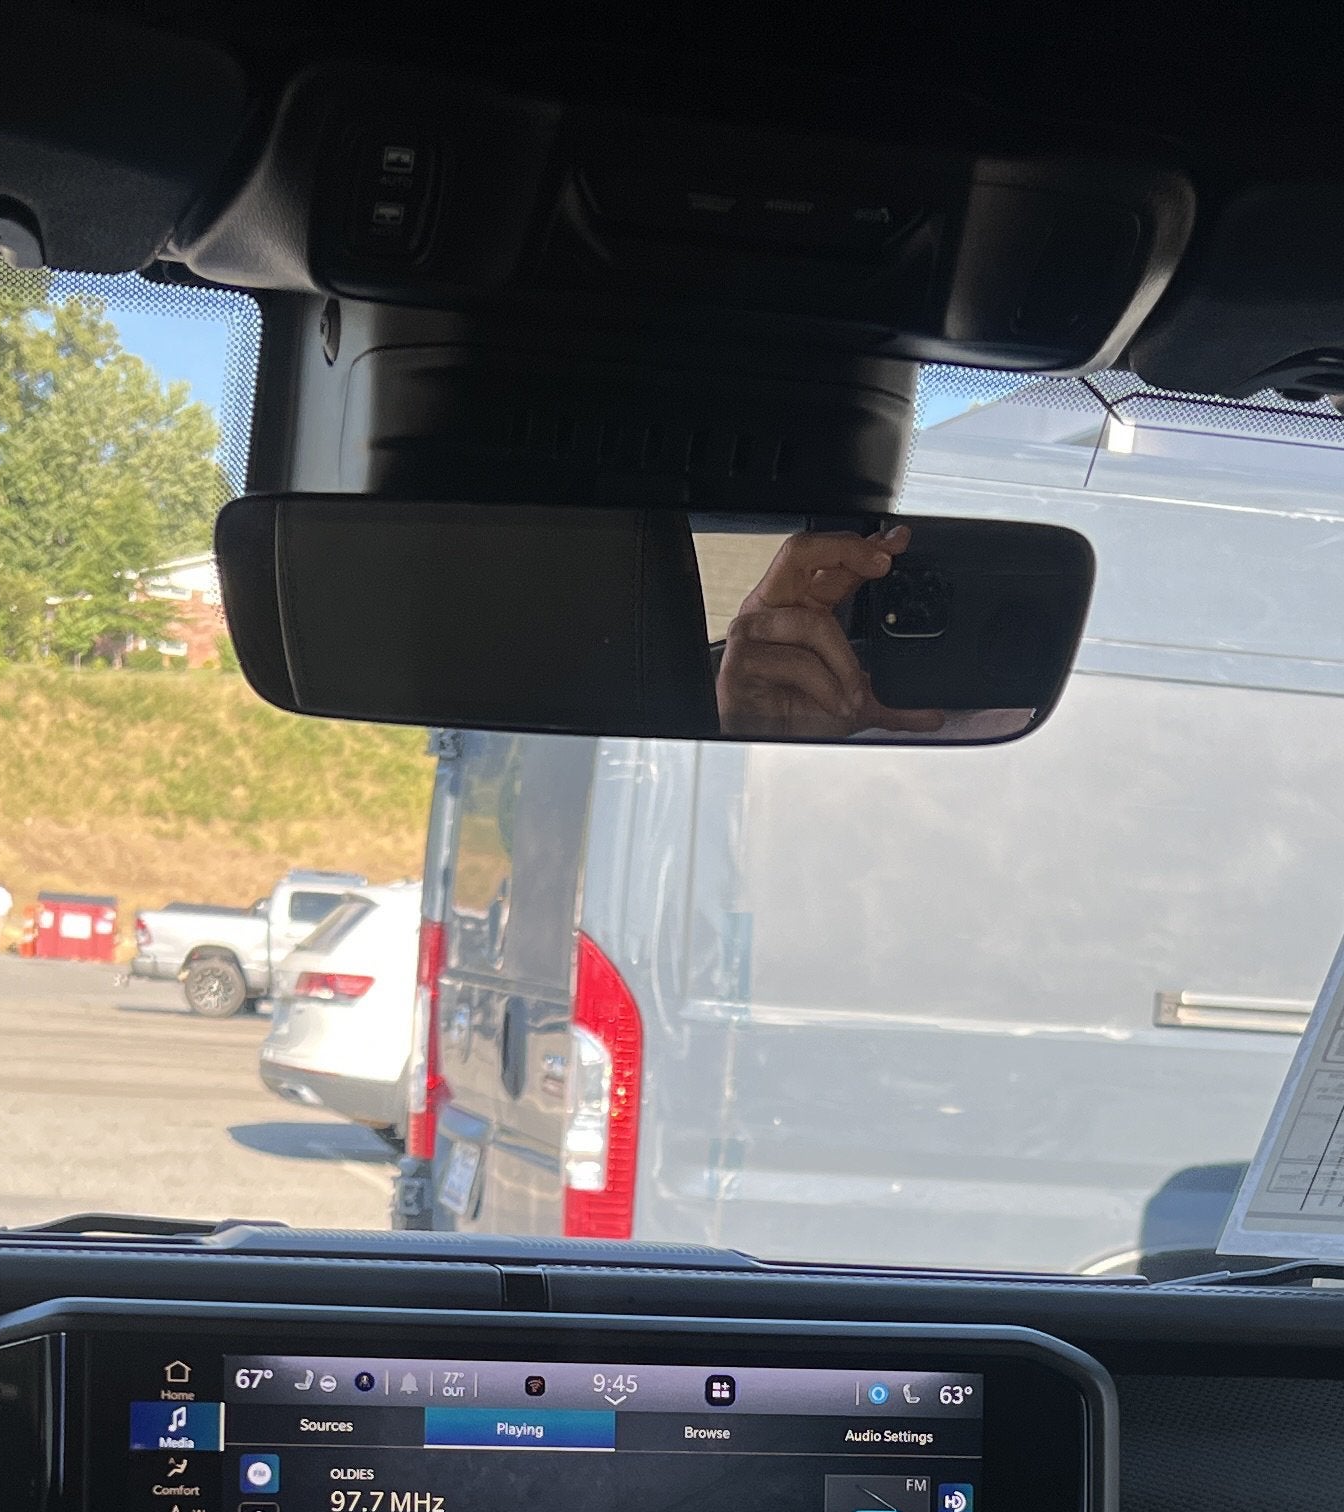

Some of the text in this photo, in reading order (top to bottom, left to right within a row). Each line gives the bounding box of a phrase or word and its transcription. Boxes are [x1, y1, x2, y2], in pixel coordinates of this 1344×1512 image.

[593, 1374, 638, 1393] 9:45
[161, 1390, 195, 1400] Home
[442, 1387, 465, 1397] OUT
[300, 1418, 353, 1432] Sources
[496, 1422, 544, 1438] Playing
[684, 1427, 730, 1439] Browse
[845, 1430, 933, 1445] Audio Settings
[159, 1437, 194, 1449] Media
[330, 1468, 374, 1480] OLDIES
[153, 1485, 200, 1496] Comfort
[906, 1479, 927, 1492] FM
[330, 1491, 445, 1512] 97.7 MHz
